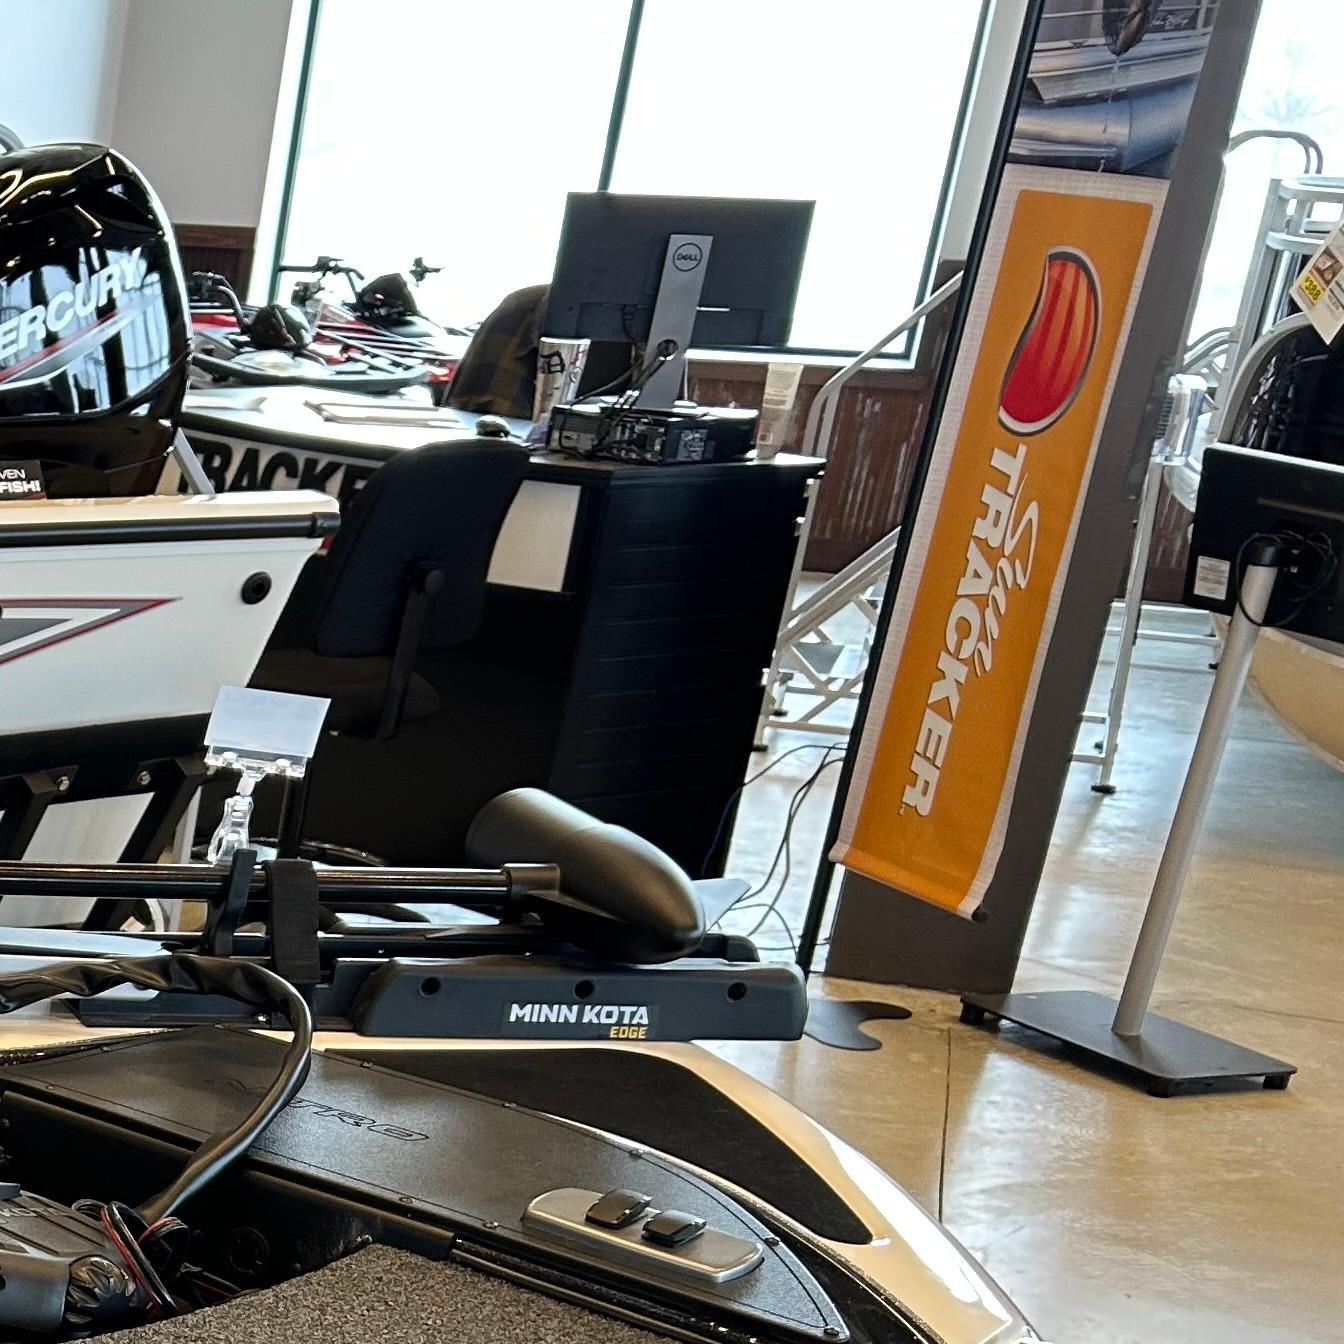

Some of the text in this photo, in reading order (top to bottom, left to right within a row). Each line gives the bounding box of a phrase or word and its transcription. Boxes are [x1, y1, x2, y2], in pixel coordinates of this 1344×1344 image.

[901, 443, 1027, 818] TRACKER
[509, 1003, 649, 1025] MINN KOTA
[609, 1026, 648, 1039] EDGE
